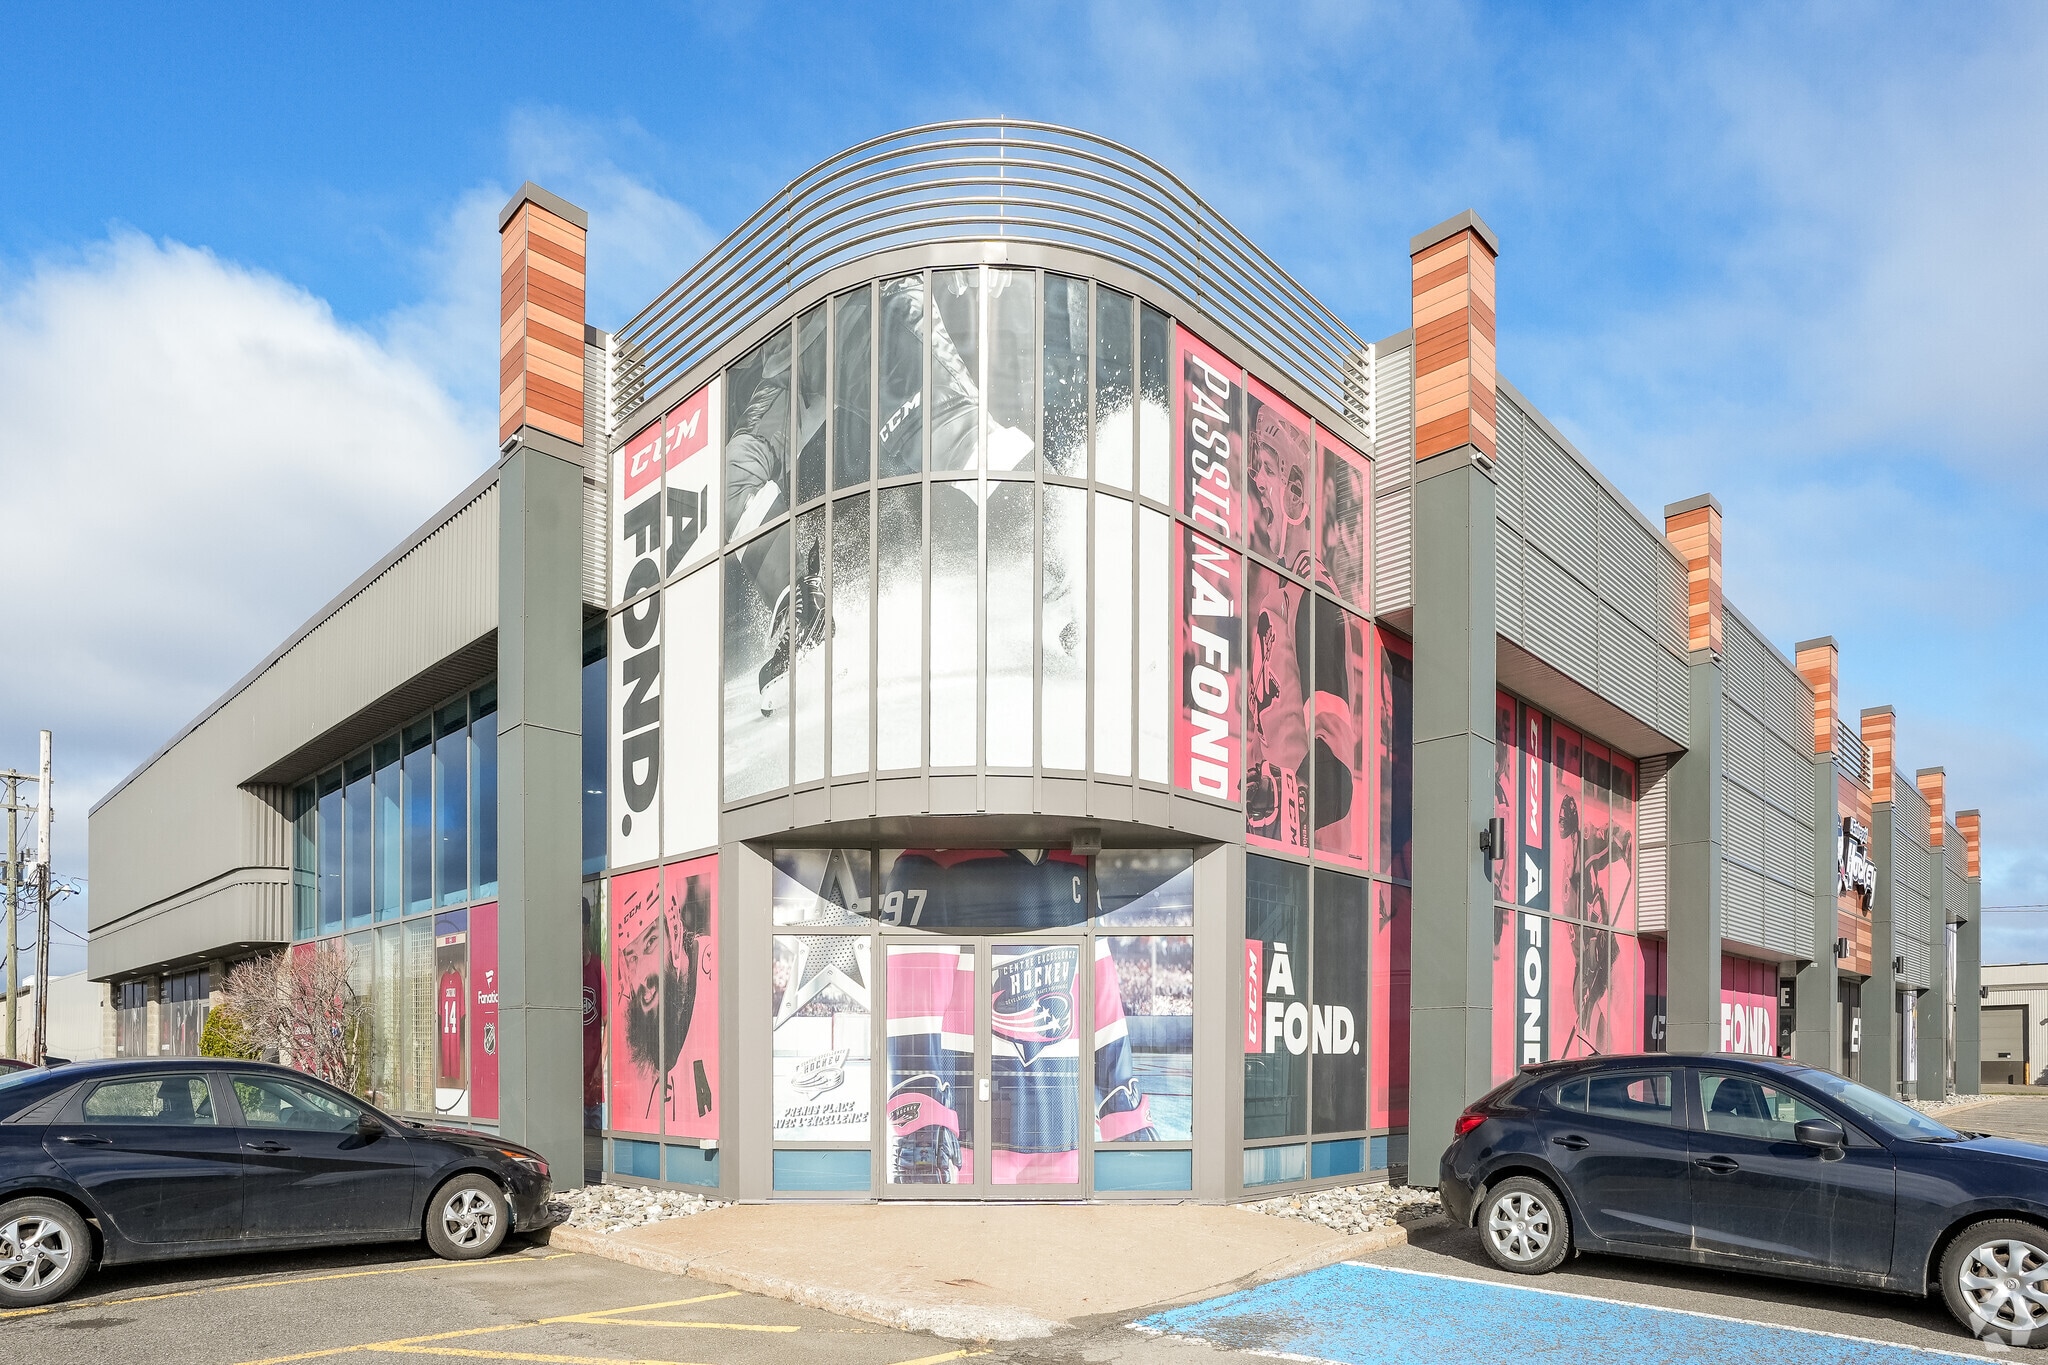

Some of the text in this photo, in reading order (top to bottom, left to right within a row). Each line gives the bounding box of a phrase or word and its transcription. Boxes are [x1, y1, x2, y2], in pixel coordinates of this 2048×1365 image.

[630, 408, 702, 478] CCM
[879, 391, 921, 443] CCM
[622, 491, 661, 838] FOND.
[1190, 624, 1230, 801] FOND
[1529, 717, 1539, 838] CCM
[1286, 773, 1298, 846] CCM
[623, 902, 642, 924] CCM
[880, 889, 928, 926] 97
[1071, 875, 1081, 904] C
[1003, 958, 1034, 976] CENTRE
[1009, 961, 1070, 996] HOCKEY
[444, 1000, 457, 1034] 14
[1248, 948, 1258, 1045] CCM
[1265, 1001, 1360, 1056] FOND.
